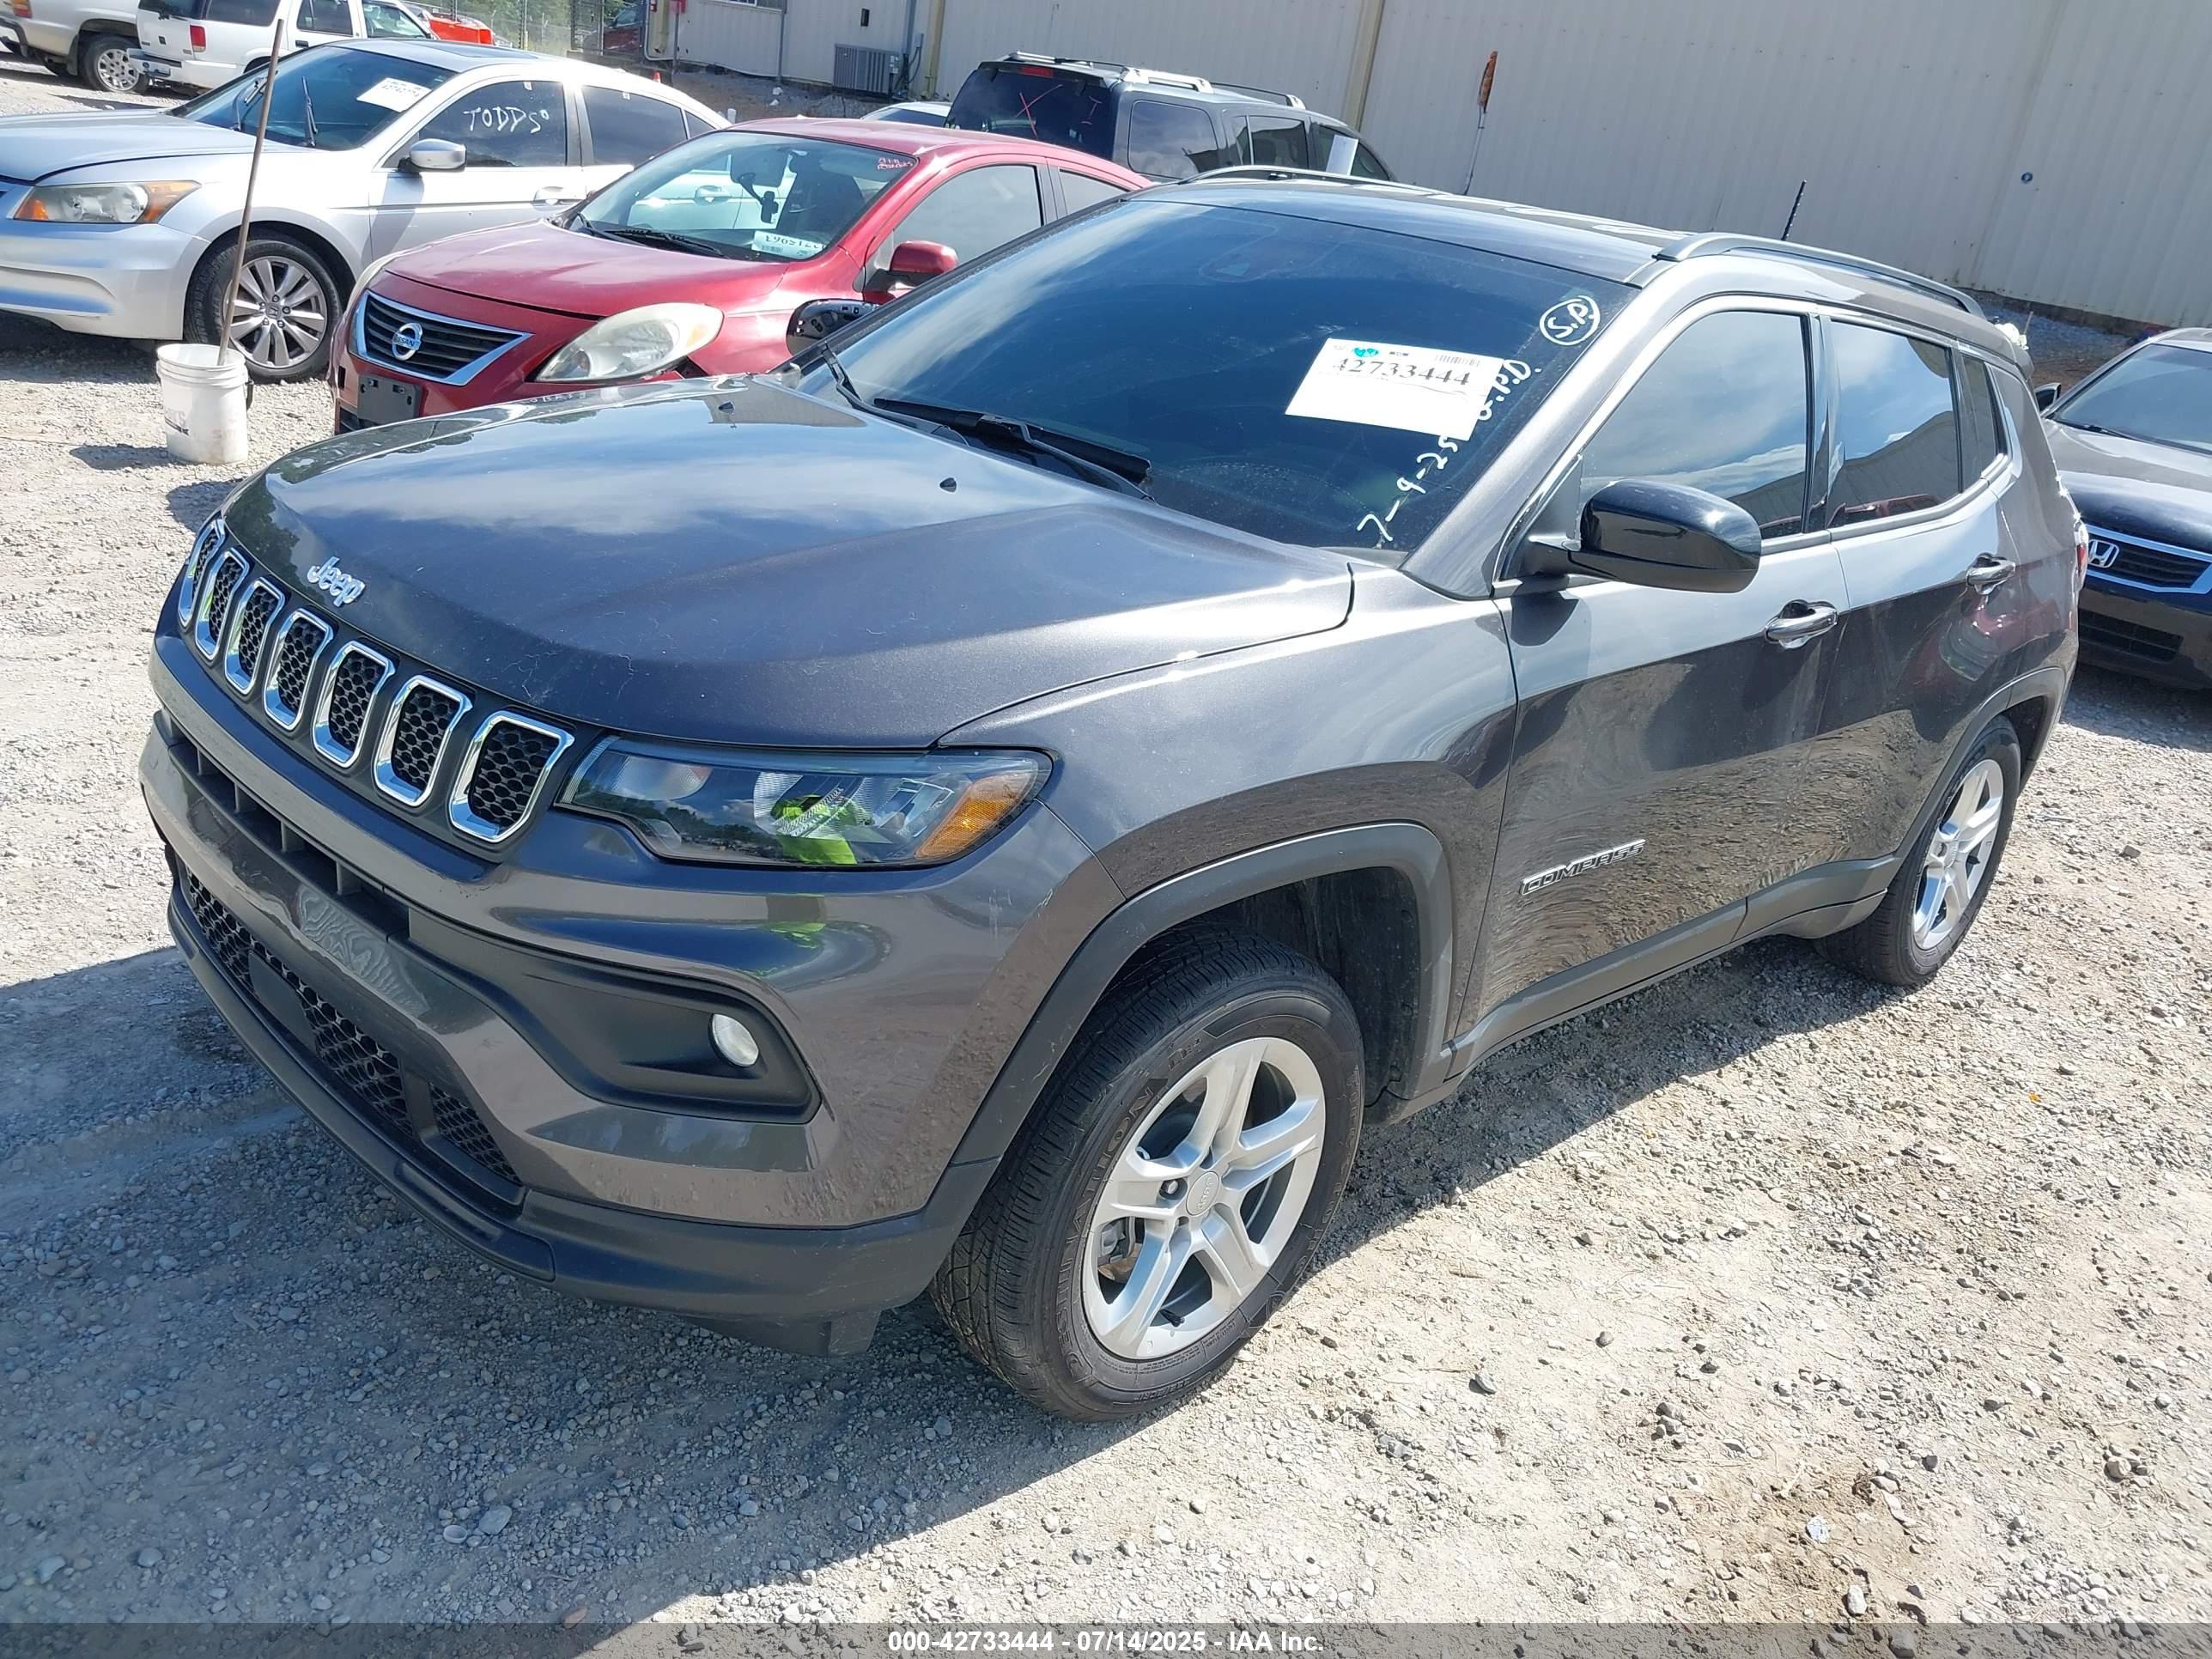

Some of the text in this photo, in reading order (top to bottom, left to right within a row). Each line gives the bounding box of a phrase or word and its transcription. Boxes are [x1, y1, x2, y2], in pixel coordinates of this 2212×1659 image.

[1334, 358, 1471, 386] 42733444
[307, 556, 366, 607] Jeep
[1519, 838, 1647, 896] COMPASS
